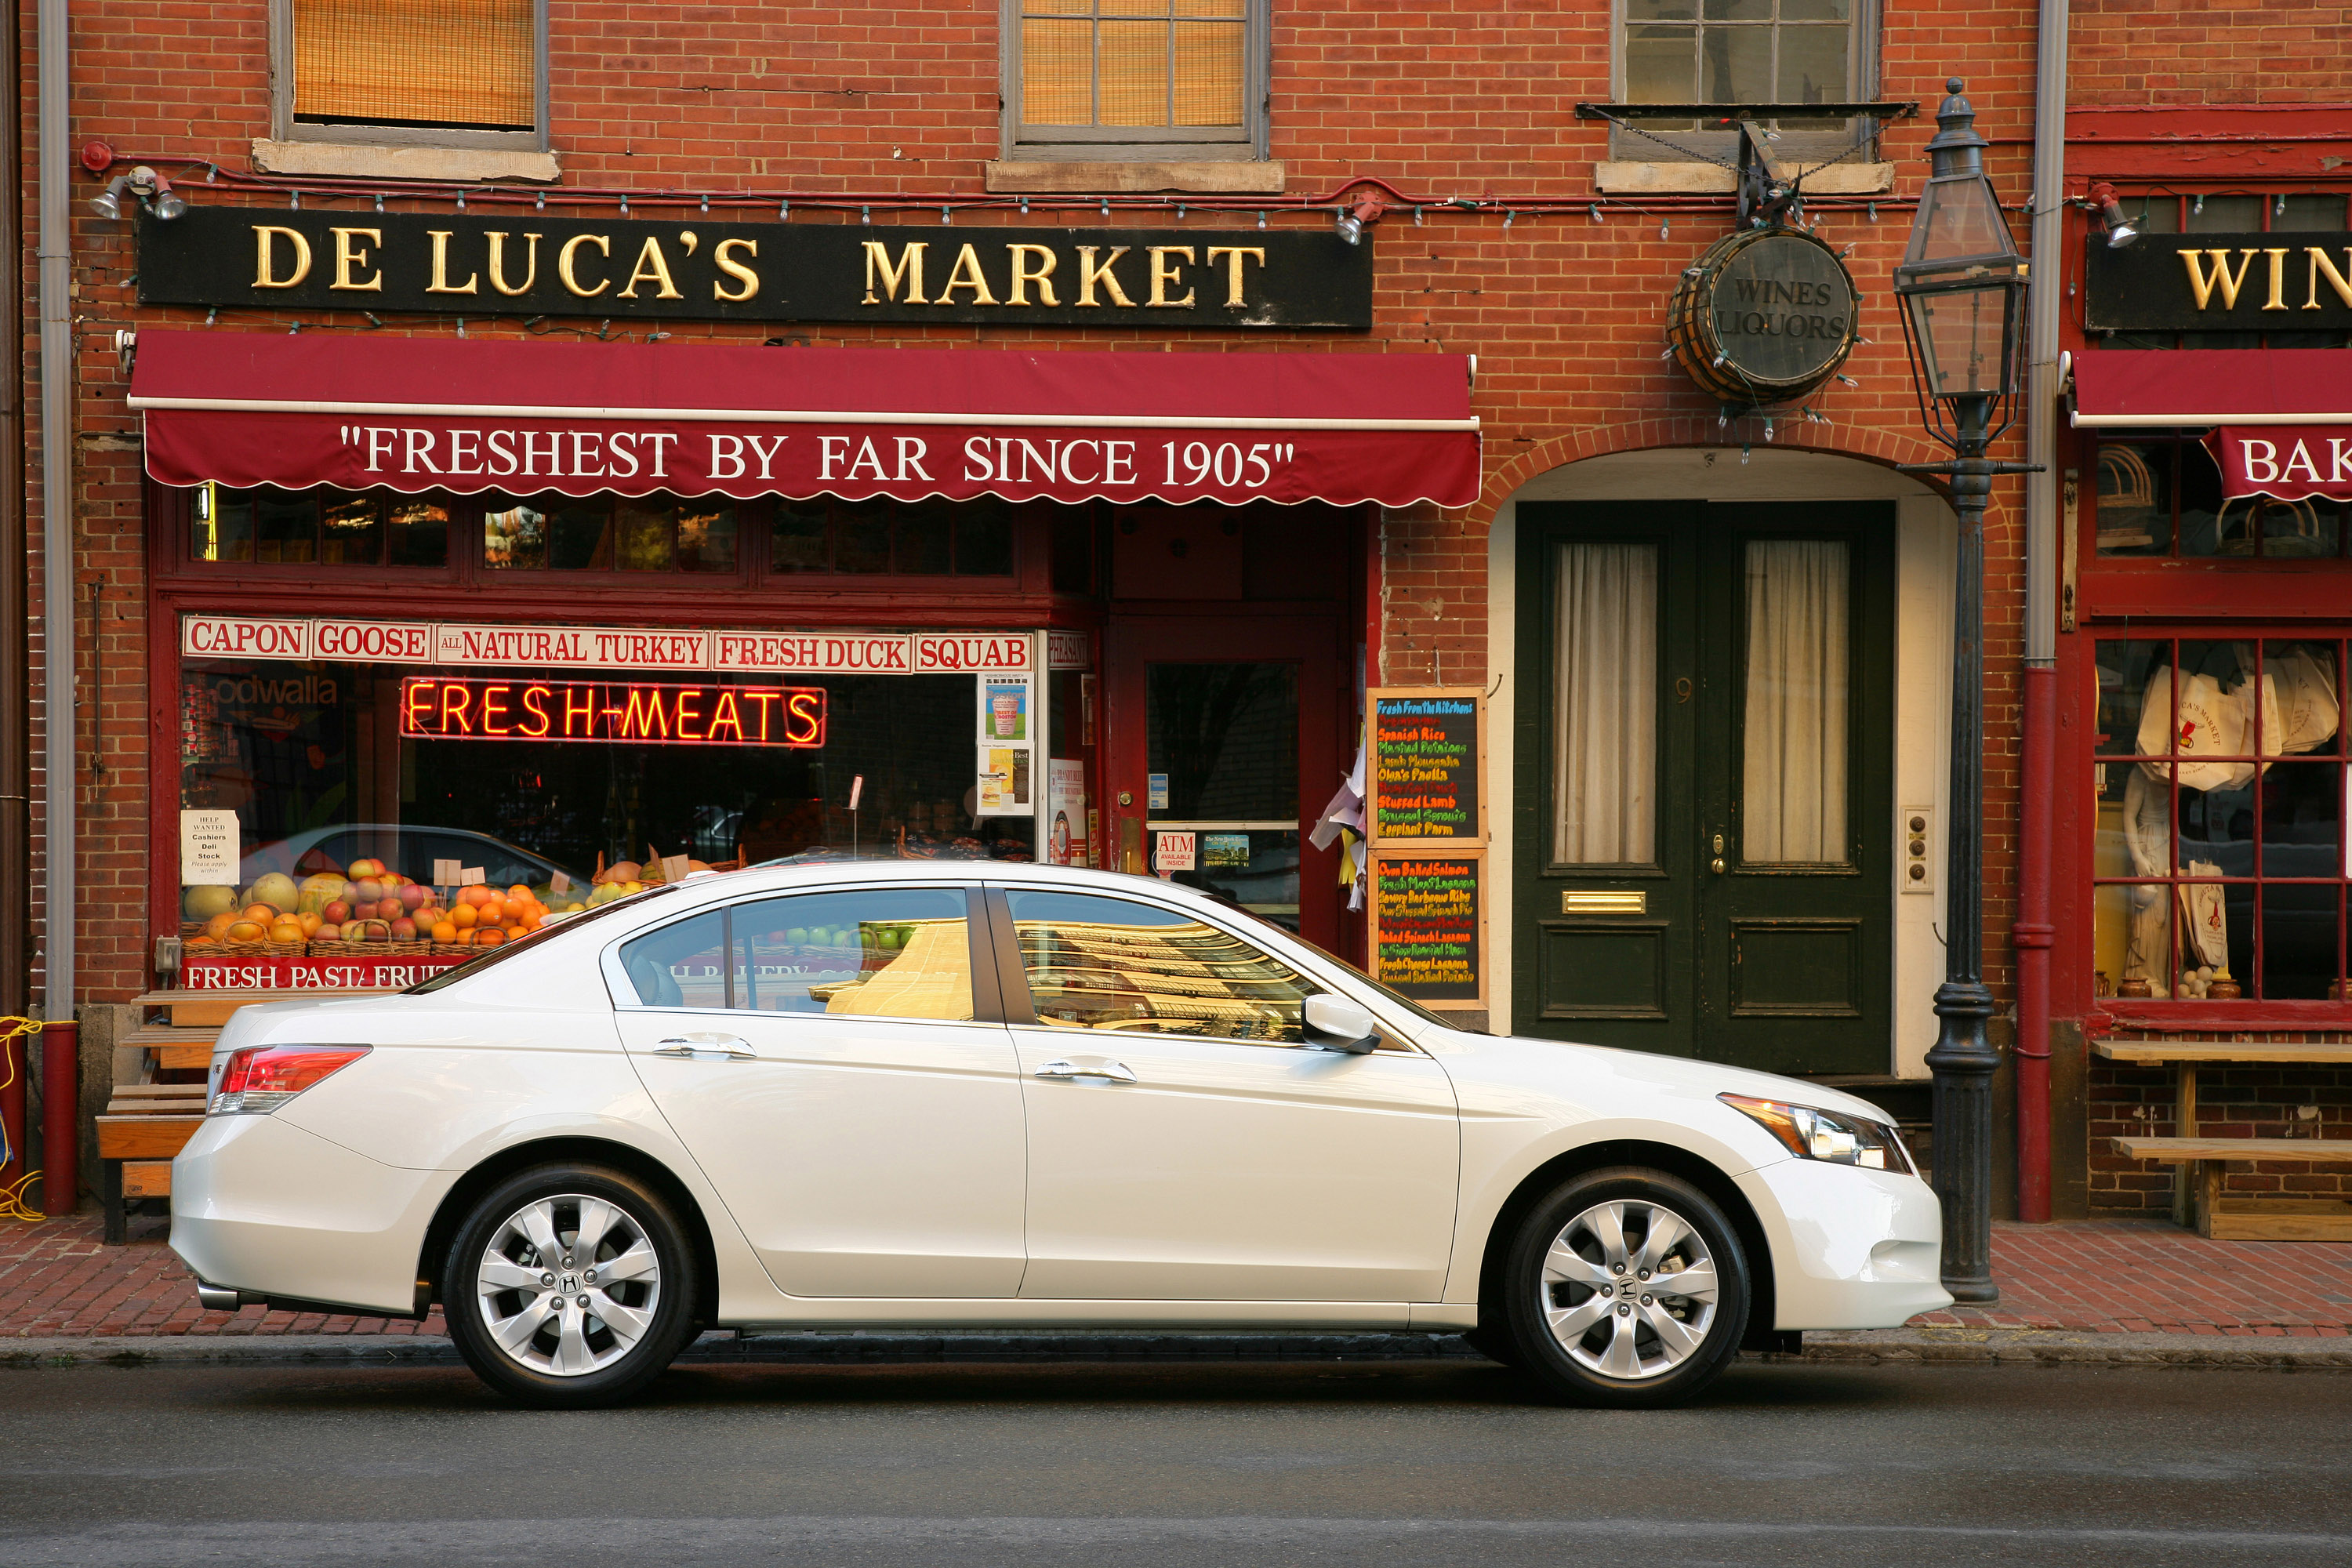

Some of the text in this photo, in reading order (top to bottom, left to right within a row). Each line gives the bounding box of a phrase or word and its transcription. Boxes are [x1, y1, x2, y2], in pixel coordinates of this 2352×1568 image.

[251, 224, 759, 302] DE LUCA'S
[860, 241, 1266, 309] MARKET
[1735, 277, 1832, 307] WINES
[1717, 309, 1845, 340] LIQUORS
[340, 425, 1295, 488] "FRESHEST BY FAR SINCE 1905"
[191, 621, 303, 655] CAPON
[318, 625, 426, 658] GOOSE
[440, 631, 704, 665] ALL NATURAL TURKEY
[1050, 636, 1086, 664] PHEASANT
[719, 637, 907, 670] FRESH DUCK
[920, 638, 1027, 670] SQUAB
[214, 673, 337, 704] odwalla
[1675, 677, 1693, 704] 9
[1377, 700, 1403, 715] Fresh
[1377, 727, 1446, 742] Spanish Rice
[2181, 702, 2221, 746] CA'S MARKET
[1411, 768, 1449, 782] Paella
[1422, 795, 1457, 809] Lamb
[1424, 822, 1454, 836] Parm
[1158, 835, 1194, 853] ATM
[1433, 862, 1469, 877] Salmon
[1449, 888, 1471, 903] Ribs
[1403, 930, 1435, 944] Spinach
[187, 966, 278, 989] FRESH
[373, 965, 455, 987] FRUI
